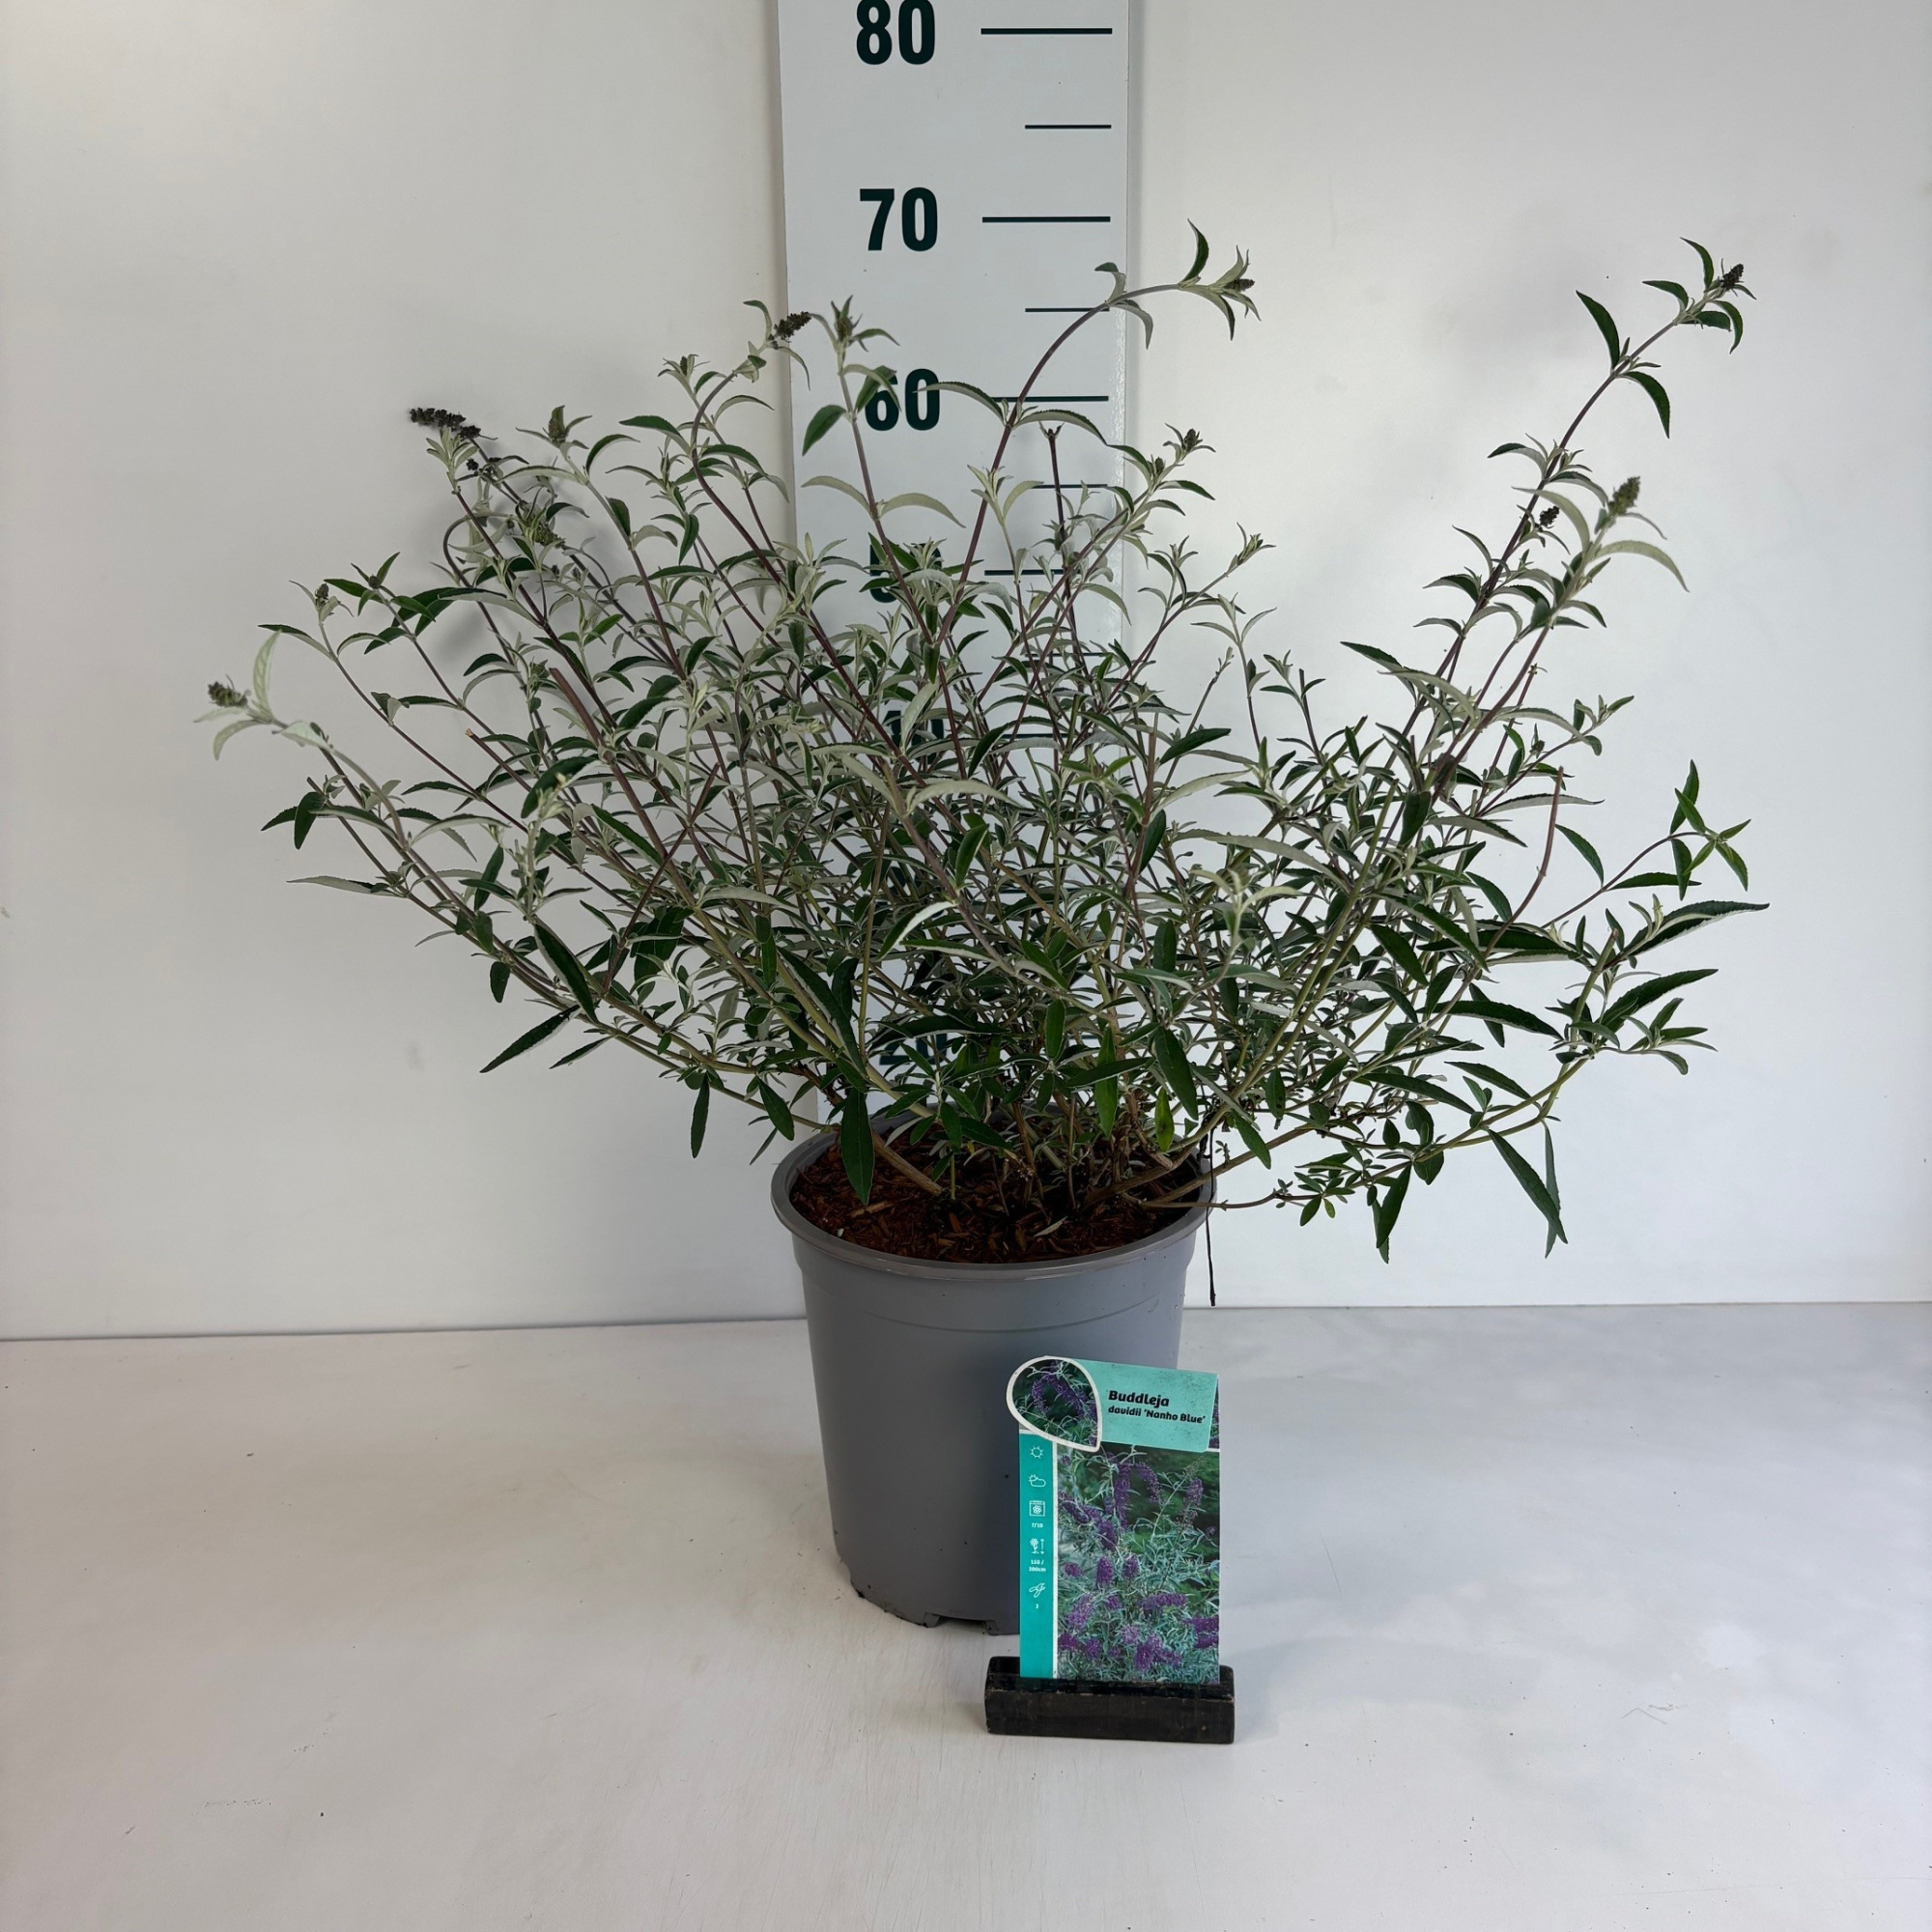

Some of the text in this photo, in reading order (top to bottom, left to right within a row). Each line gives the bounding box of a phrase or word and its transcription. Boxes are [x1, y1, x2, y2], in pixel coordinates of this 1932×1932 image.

[857, 0, 935, 65] 80
[860, 186, 938, 251] 70
[865, 368, 940, 432] 60
[1108, 1390, 1170, 1408] Buddleja
[1108, 1406, 1142, 1417] davidii
